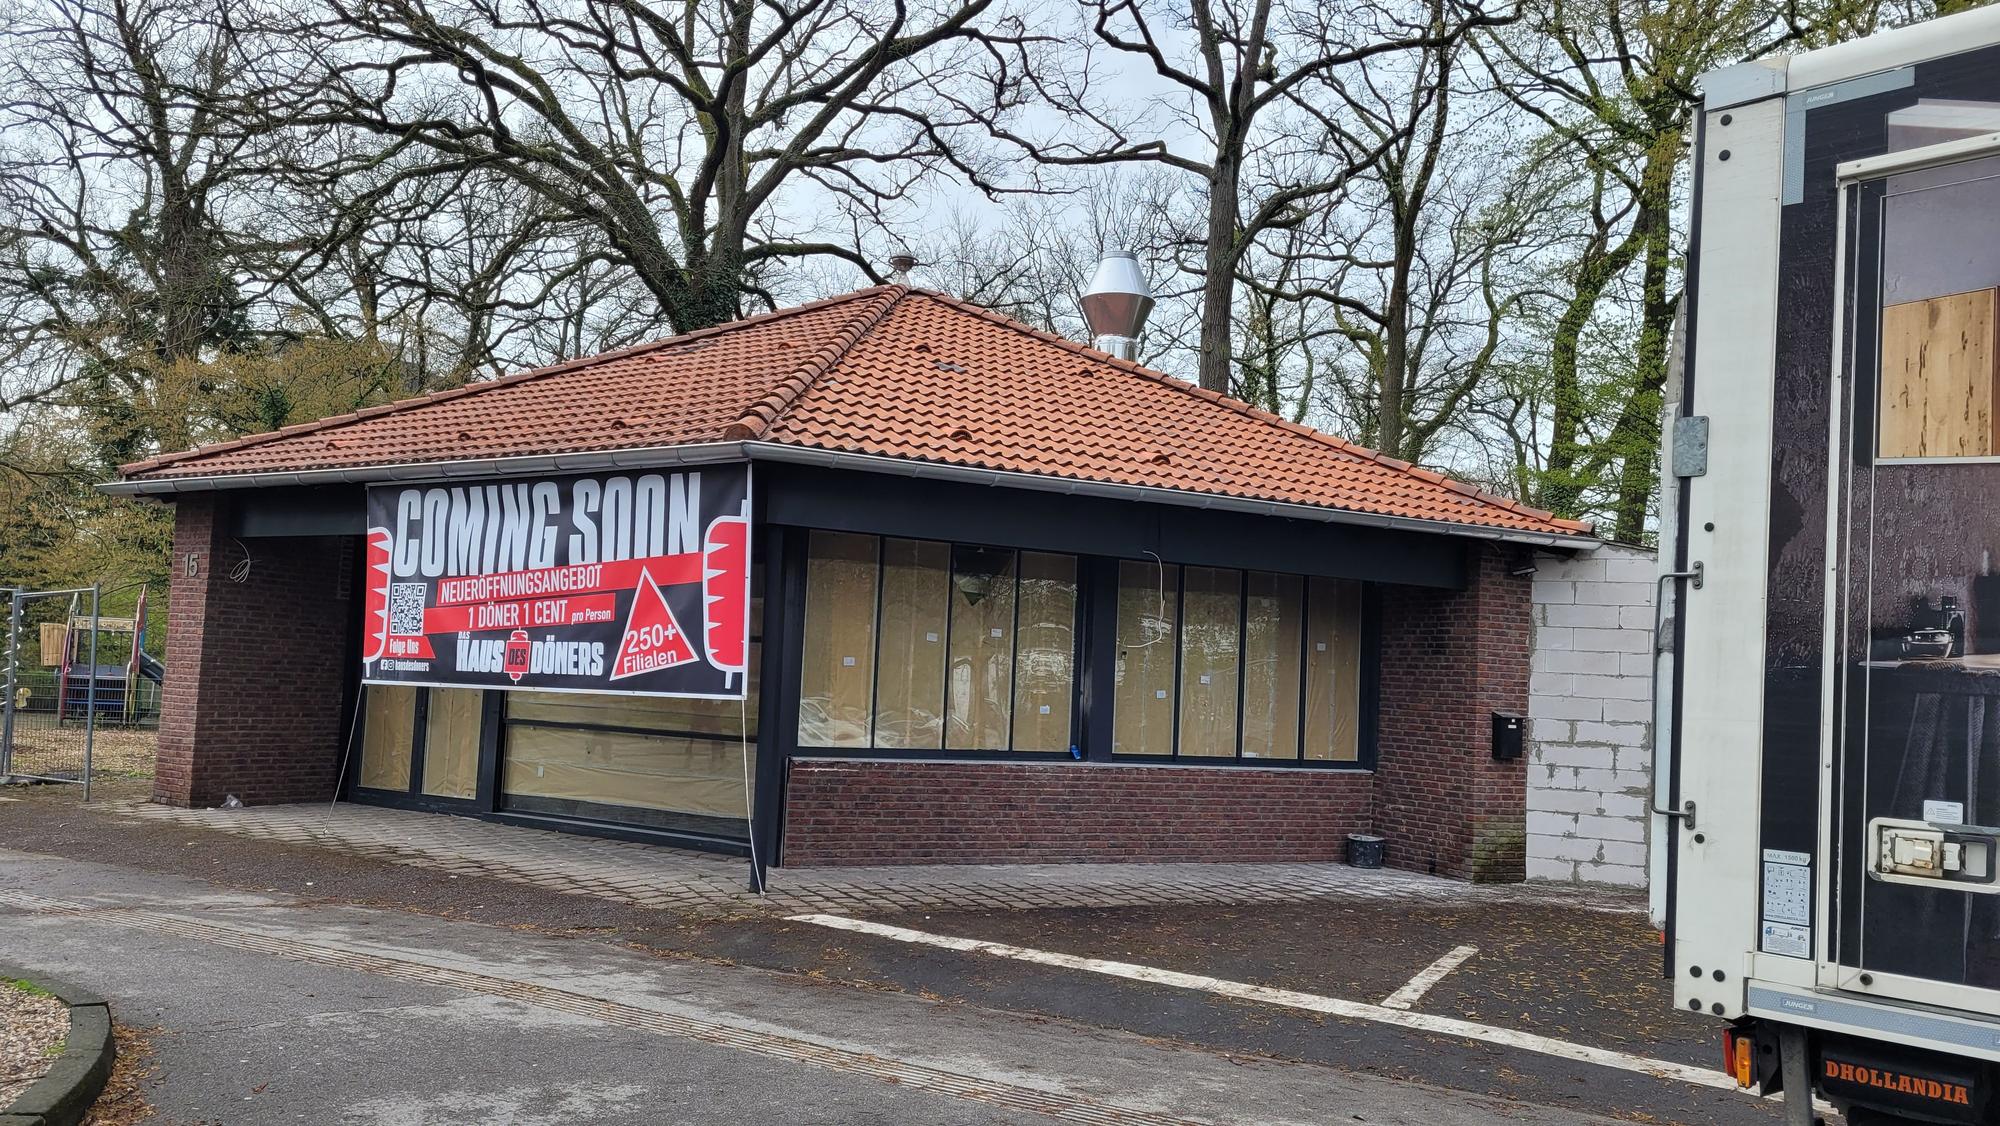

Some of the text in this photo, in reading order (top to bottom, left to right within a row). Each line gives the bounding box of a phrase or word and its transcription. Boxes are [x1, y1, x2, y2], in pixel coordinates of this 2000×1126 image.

[393, 472, 700, 577] COMING SOON
[182, 553, 199, 577] 15
[441, 565, 602, 604] NEUERÖFFNUNGSANGEBOT
[468, 600, 611, 628] 1 DÖNER 1 CENT pro Person
[390, 638, 406, 656] Folge
[458, 631, 470, 639] DAS
[626, 623, 676, 653] 250+
[456, 635, 604, 676] HAUS DES DÖNERS
[623, 649, 677, 674] Filialen
[1826, 1060, 1969, 1105] DHOLLANDIA
